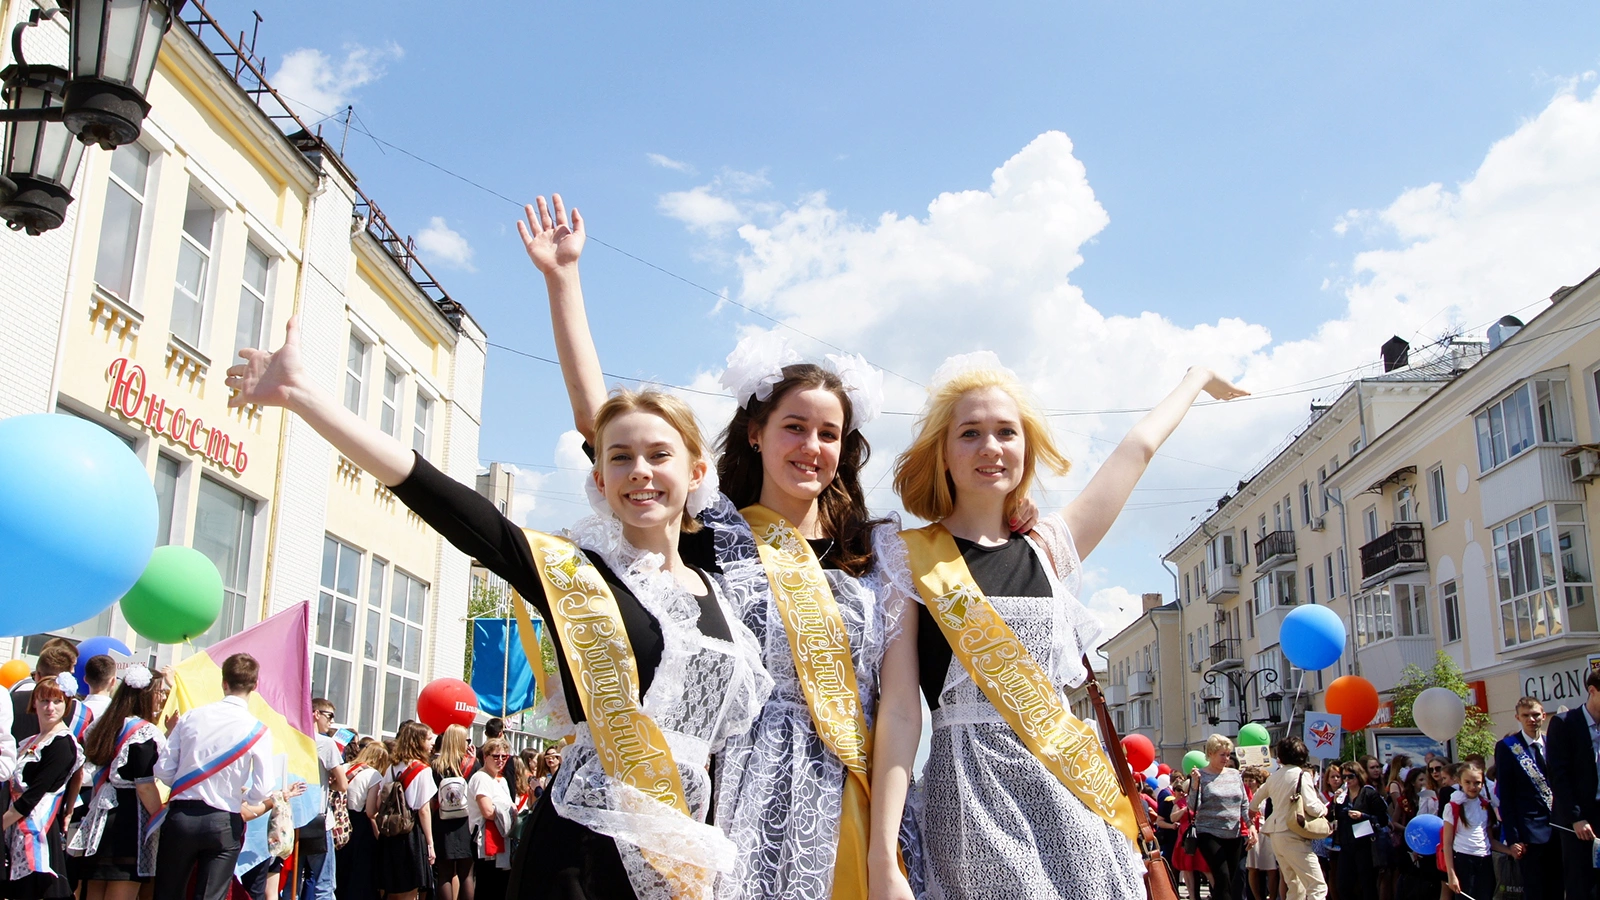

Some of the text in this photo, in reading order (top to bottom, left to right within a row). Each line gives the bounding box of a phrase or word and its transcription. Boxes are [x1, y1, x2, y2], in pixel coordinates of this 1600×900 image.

[109, 358, 248, 473] Юность
[557, 591, 665, 786] Выпускник
[769, 553, 867, 774] Выпускник 2017
[959, 625, 1121, 807] Выпускник 2017
